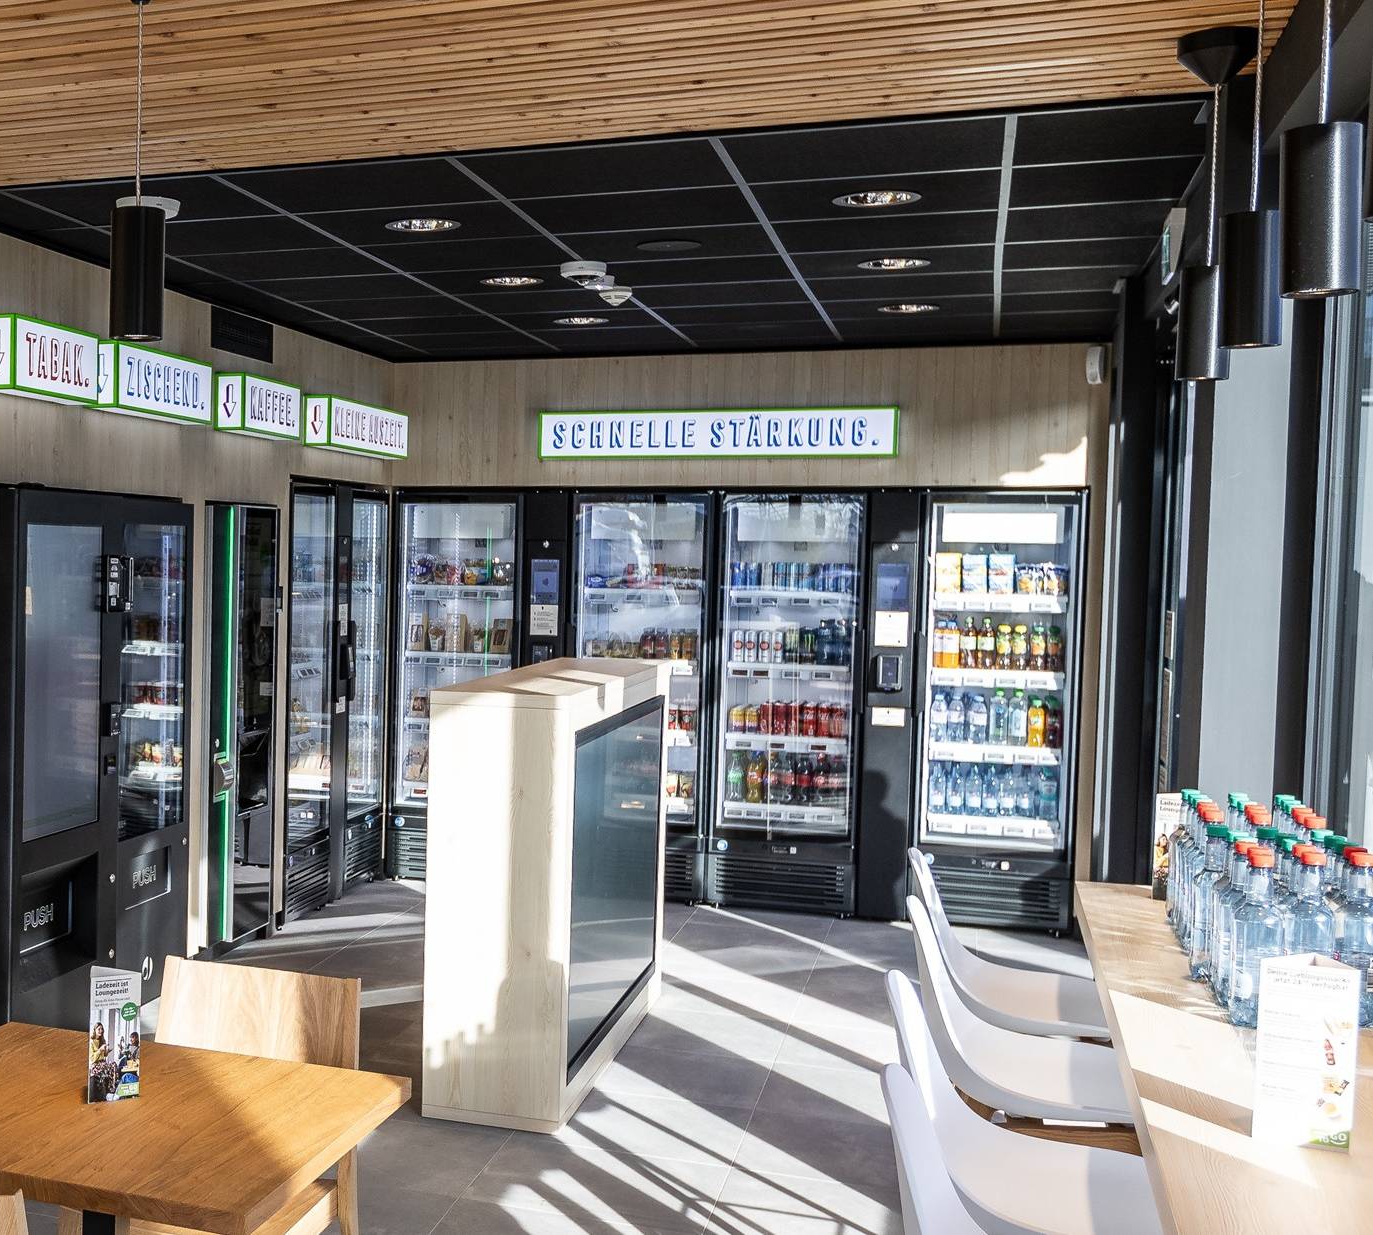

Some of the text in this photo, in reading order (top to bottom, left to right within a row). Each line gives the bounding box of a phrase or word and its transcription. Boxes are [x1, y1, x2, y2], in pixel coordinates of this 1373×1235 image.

[25, 332, 90, 389] TABAK.
[126, 356, 205, 411] ZISCHEND.
[250, 384, 296, 428] KAFFEE.
[334, 405, 405, 449] KLEINE AUSZEIT.
[552, 414, 880, 450] SCHNELLE STÄRKUNG.
[132, 864, 157, 889] PUSH
[23, 903, 55, 931] PUSH
